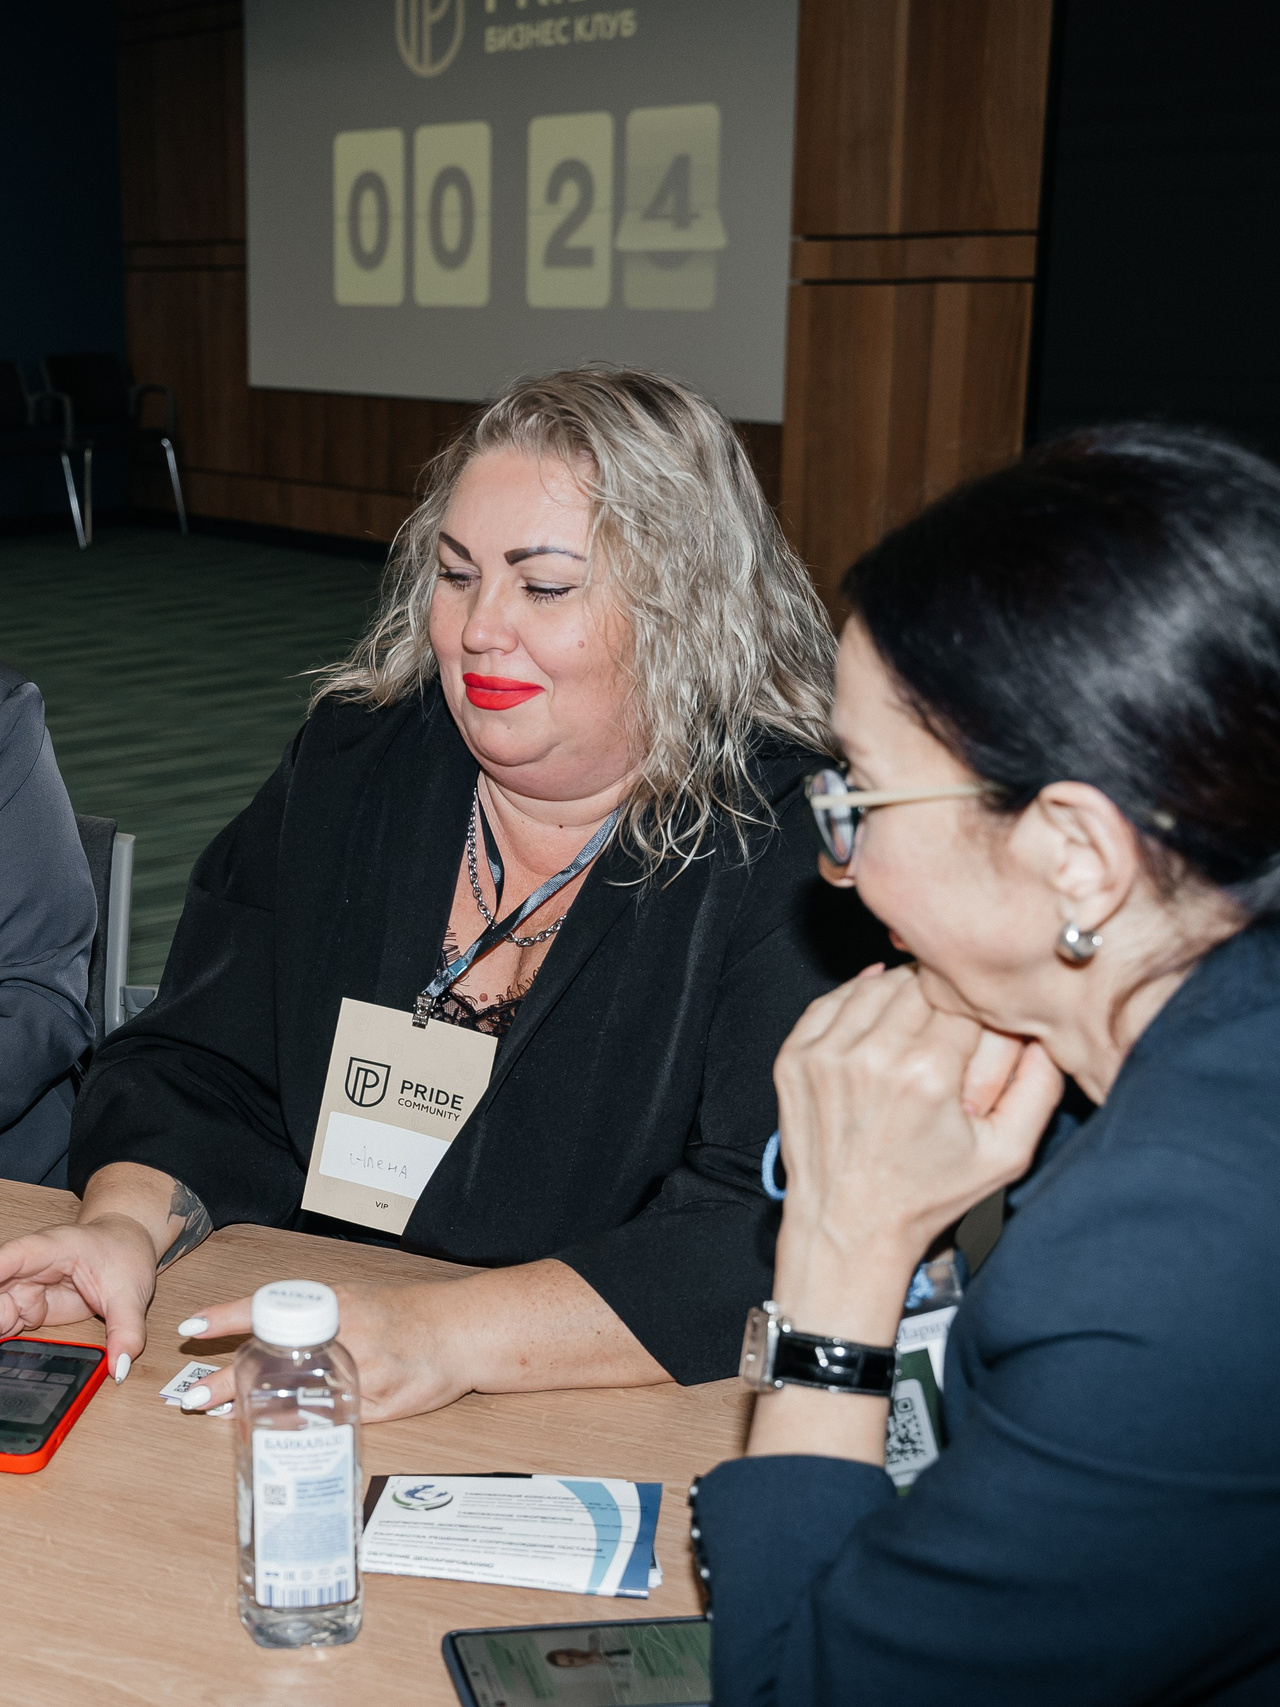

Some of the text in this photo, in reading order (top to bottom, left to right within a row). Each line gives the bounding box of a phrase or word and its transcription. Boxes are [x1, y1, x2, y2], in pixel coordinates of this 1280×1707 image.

[484, 8, 637, 53] БИЗНЕС КЛУБ
[397, 1097, 460, 1122] COMMUNITY
[399, 1080, 464, 1111] PRIDE
[375, 1201, 389, 1210] VIP
